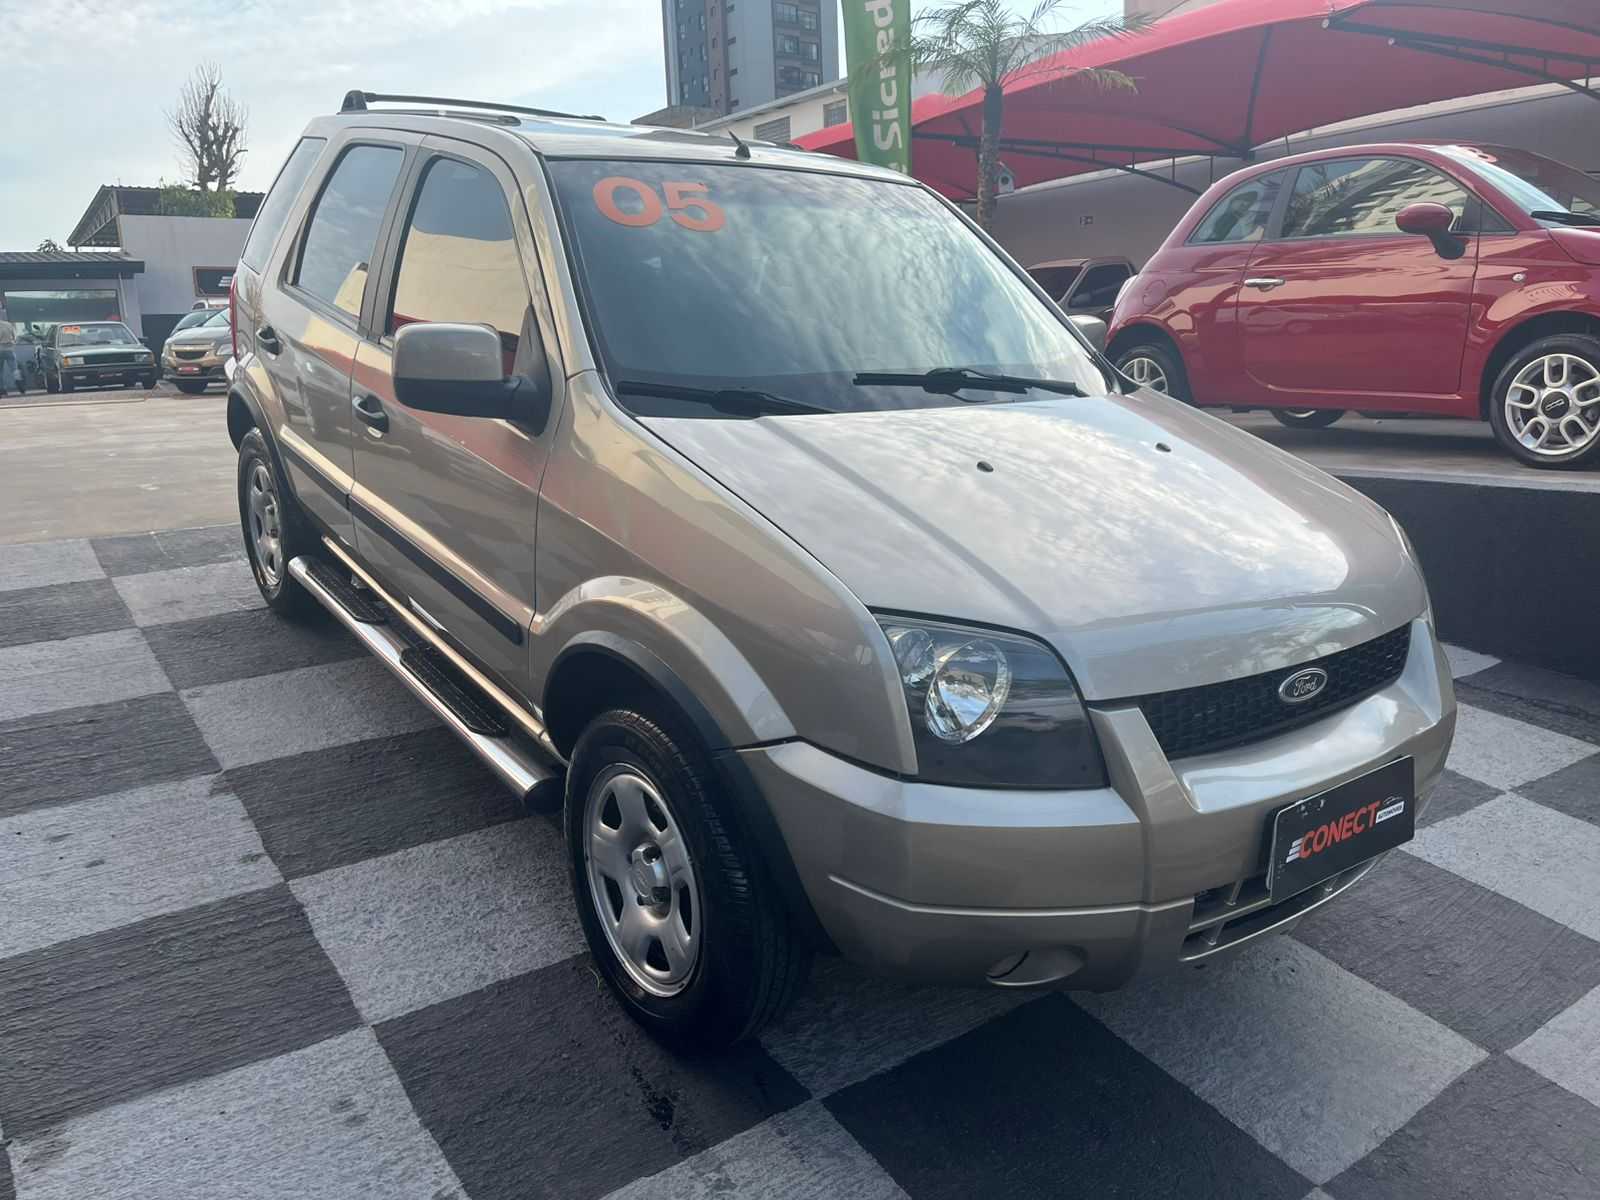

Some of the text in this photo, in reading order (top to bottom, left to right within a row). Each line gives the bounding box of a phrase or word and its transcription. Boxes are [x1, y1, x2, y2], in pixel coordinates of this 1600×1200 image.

[592, 176, 726, 232] 05
[1293, 675, 1318, 697] Ford
[1298, 799, 1382, 859] CONECT
